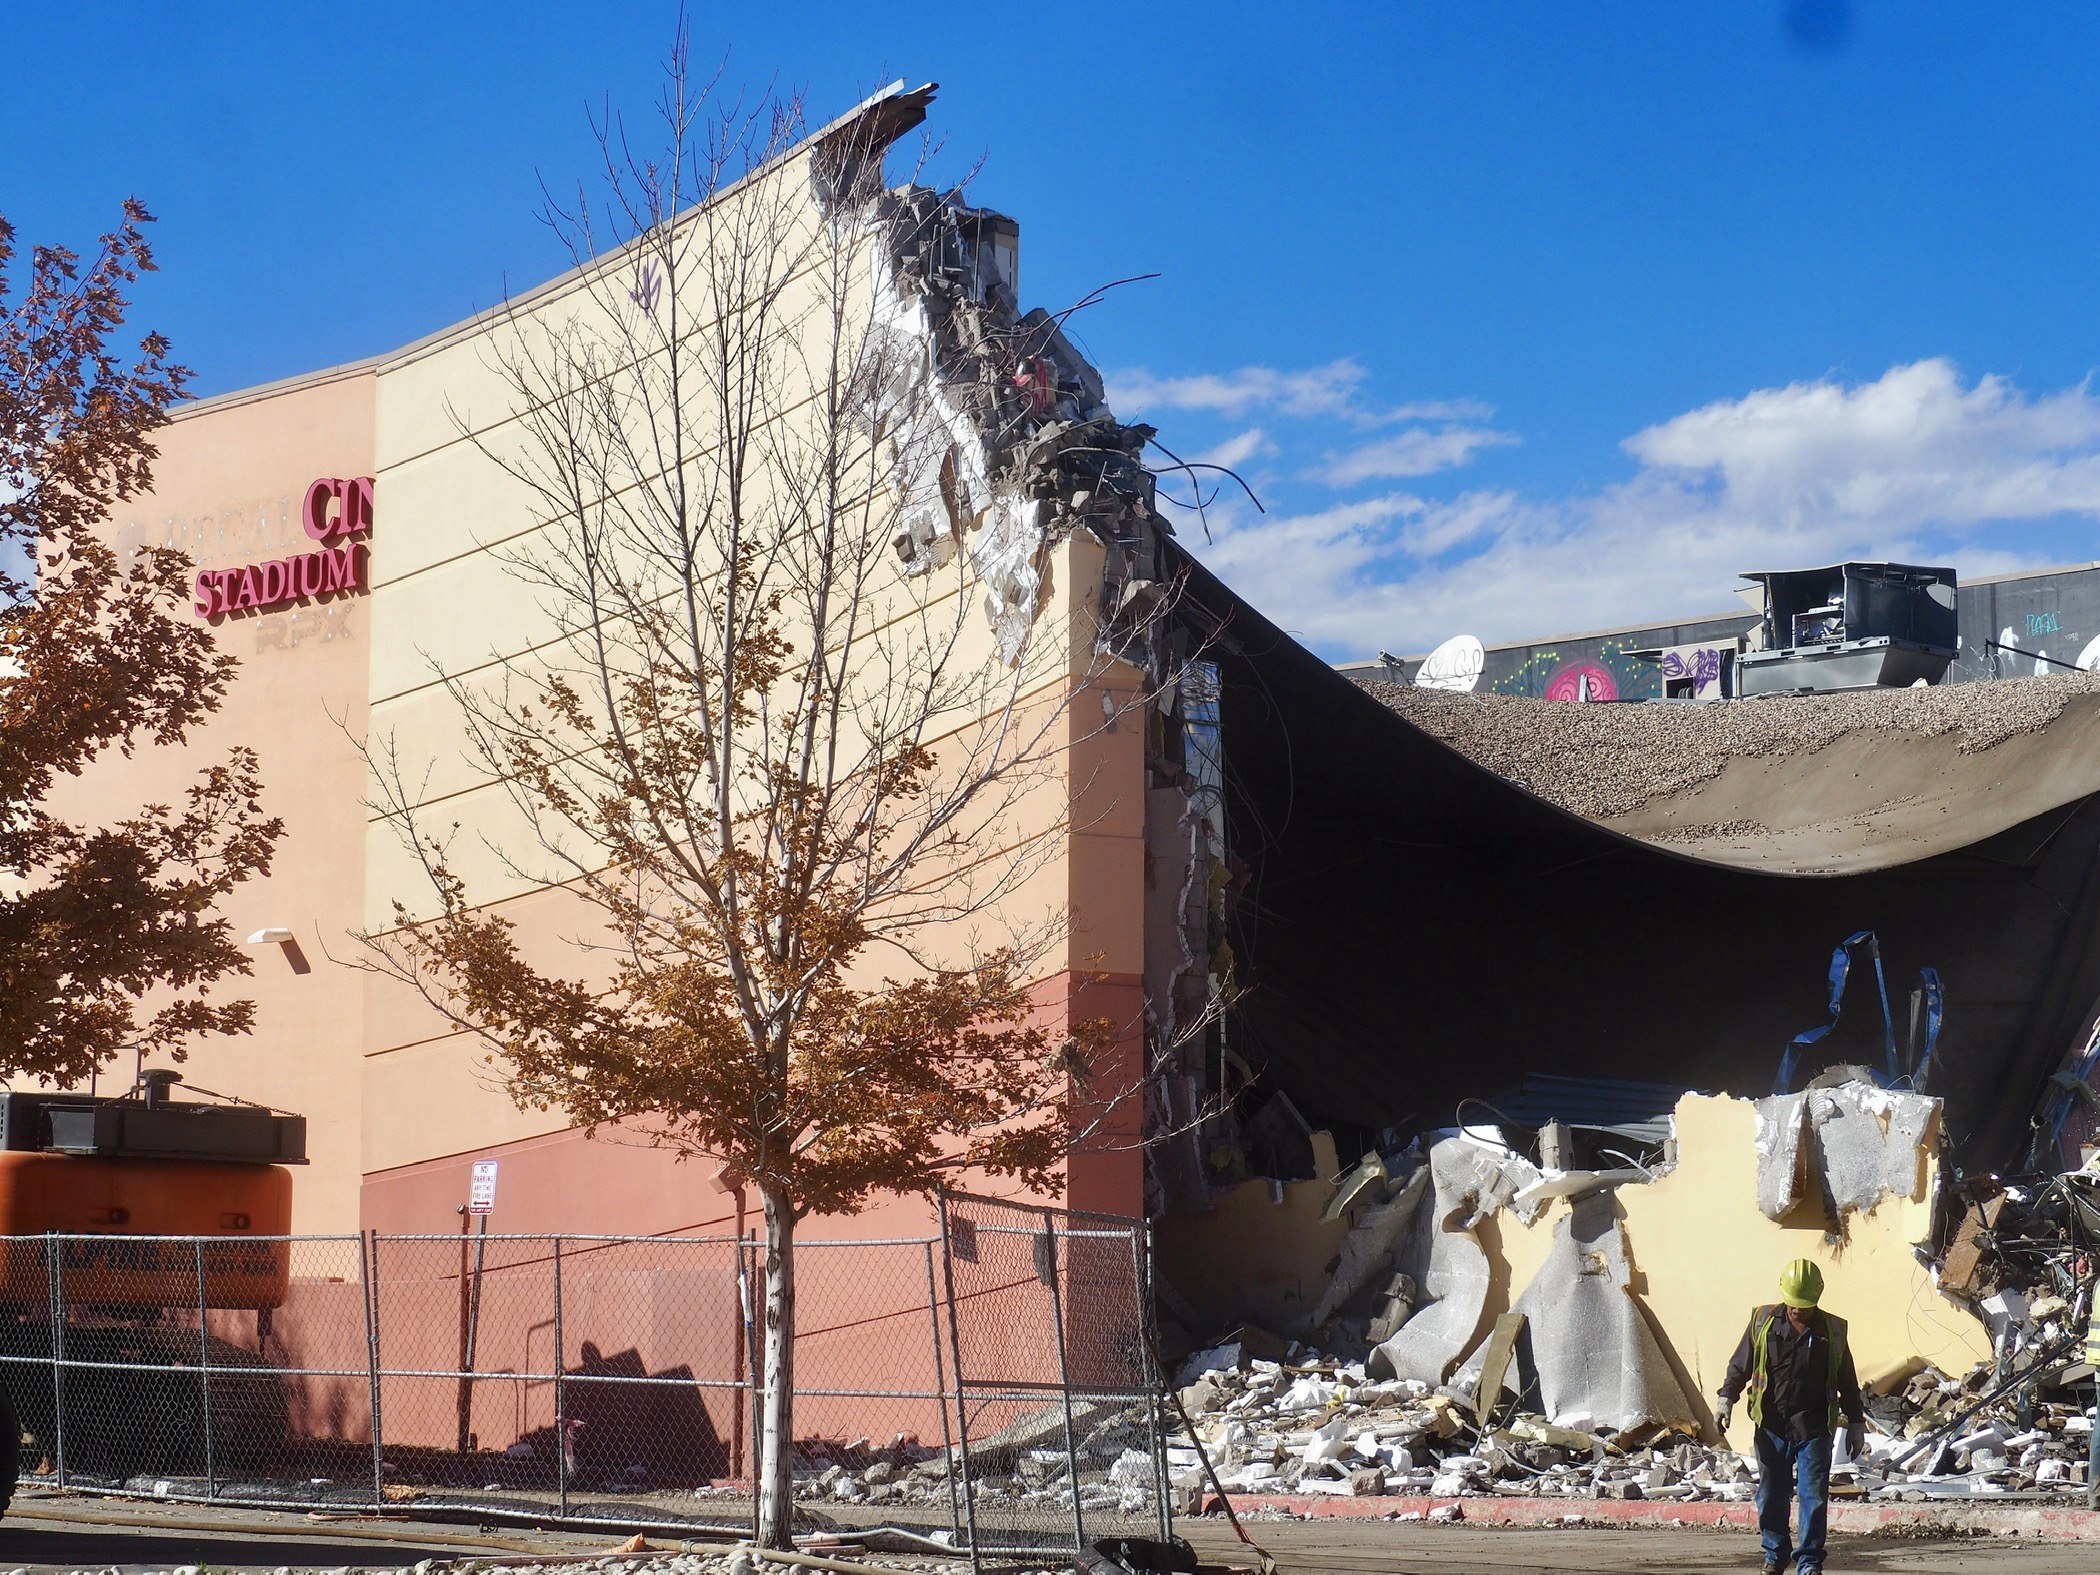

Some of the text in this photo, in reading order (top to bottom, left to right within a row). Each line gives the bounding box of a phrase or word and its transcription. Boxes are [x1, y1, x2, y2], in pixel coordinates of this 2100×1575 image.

[194, 543, 365, 619] STADIUM
[255, 603, 357, 655] RPX
[474, 1175, 494, 1183] PARKING
[481, 1165, 488, 1173] NO
